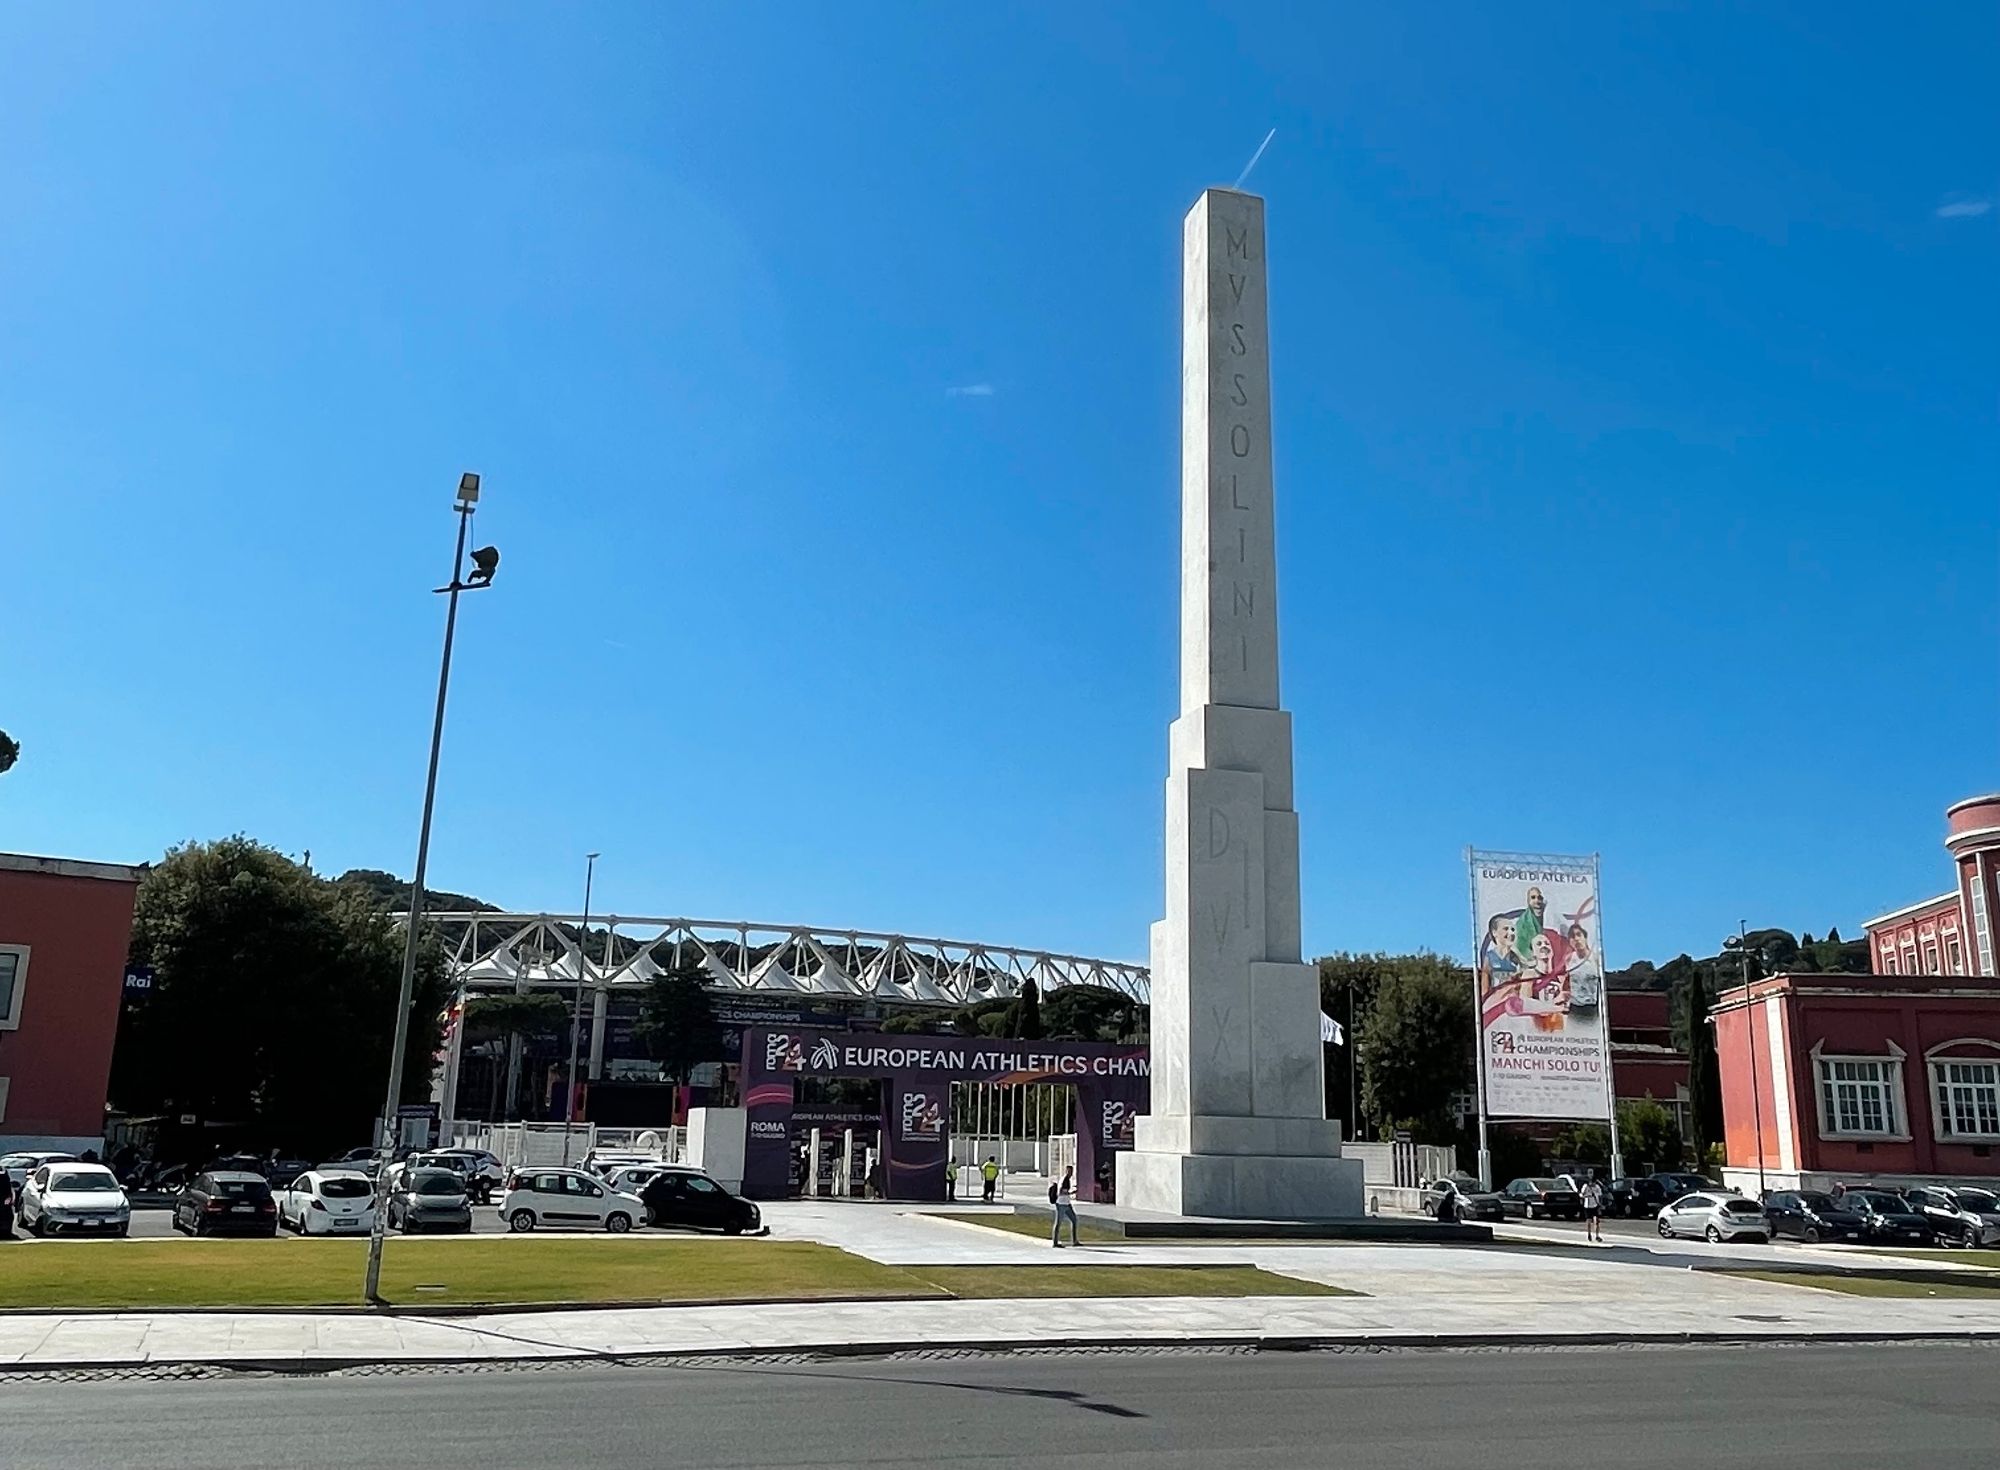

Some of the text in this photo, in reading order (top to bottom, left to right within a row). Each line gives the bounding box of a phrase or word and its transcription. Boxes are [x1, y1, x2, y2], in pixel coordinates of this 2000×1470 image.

[1225, 226, 1255, 672] MVSSOLINI
[1482, 868, 1589, 884] EUROPEI DI ATLETICA
[1208, 806, 1232, 1063] DVX
[126, 974, 152, 988] Rai
[765, 1033, 777, 1071] roma
[775, 1033, 807, 1071] 24
[1516, 1044, 1601, 1057] CHAMPIONSHIPS
[1526, 1034, 1564, 1044] EUROPEAN
[845, 1046, 964, 1070] EUROPEAN
[971, 1051, 1088, 1075] ATHLETICS
[1491, 1058, 1545, 1071] MANCHI
[1547, 1060, 1580, 1072] SOLO
[750, 1122, 786, 1133] ROMA
[902, 1092, 914, 1133] roma
[911, 1093, 945, 1133] 24
[1102, 1100, 1114, 1139] roma
